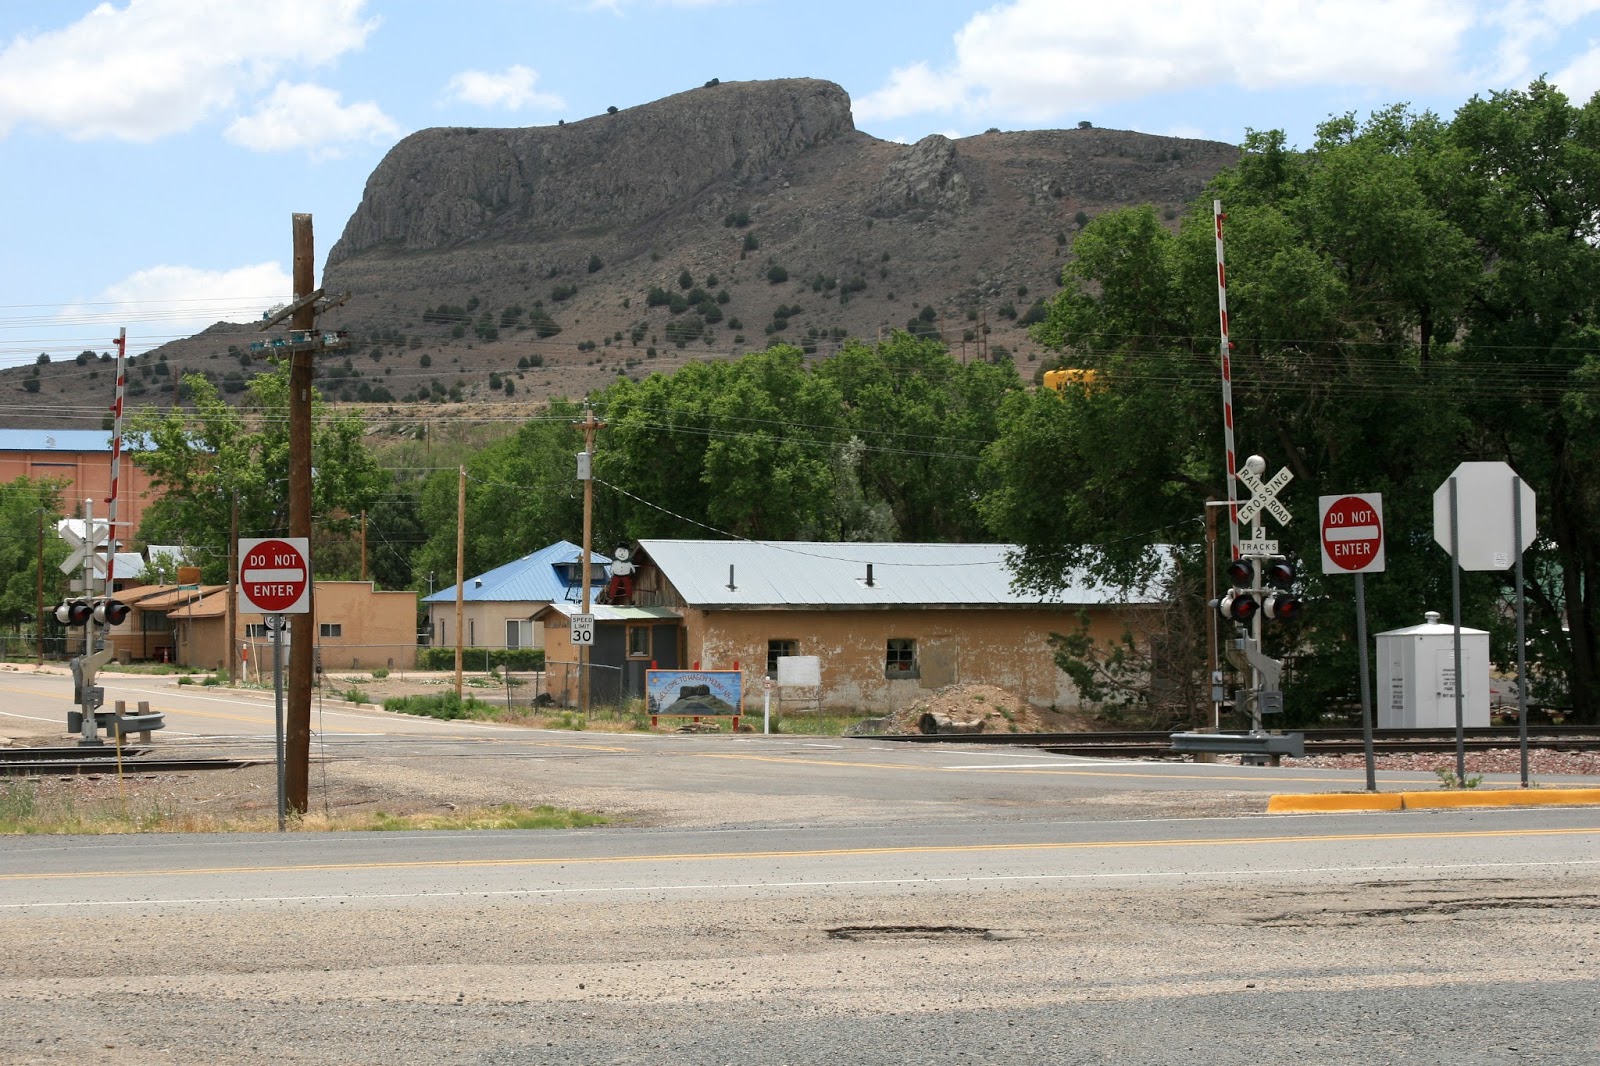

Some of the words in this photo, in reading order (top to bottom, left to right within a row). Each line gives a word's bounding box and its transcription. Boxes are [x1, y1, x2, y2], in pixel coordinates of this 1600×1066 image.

[1241, 469, 1259, 492] RAIL
[1268, 500, 1288, 522] ROAD
[1241, 472, 1288, 520] CROSSING
[1330, 512, 1344, 525] DO
[1351, 510, 1372, 523] NOT
[1255, 528, 1262, 539] 2
[1241, 543, 1277, 551] TRACKS
[1334, 542, 1371, 556] ENTER
[250, 554, 266, 567] DO
[274, 554, 297, 566] NOT
[254, 585, 294, 597] ENTER
[572, 630, 592, 642] 30
[658, 678, 679, 701] WELCOME
[678, 675, 688, 683] TO
